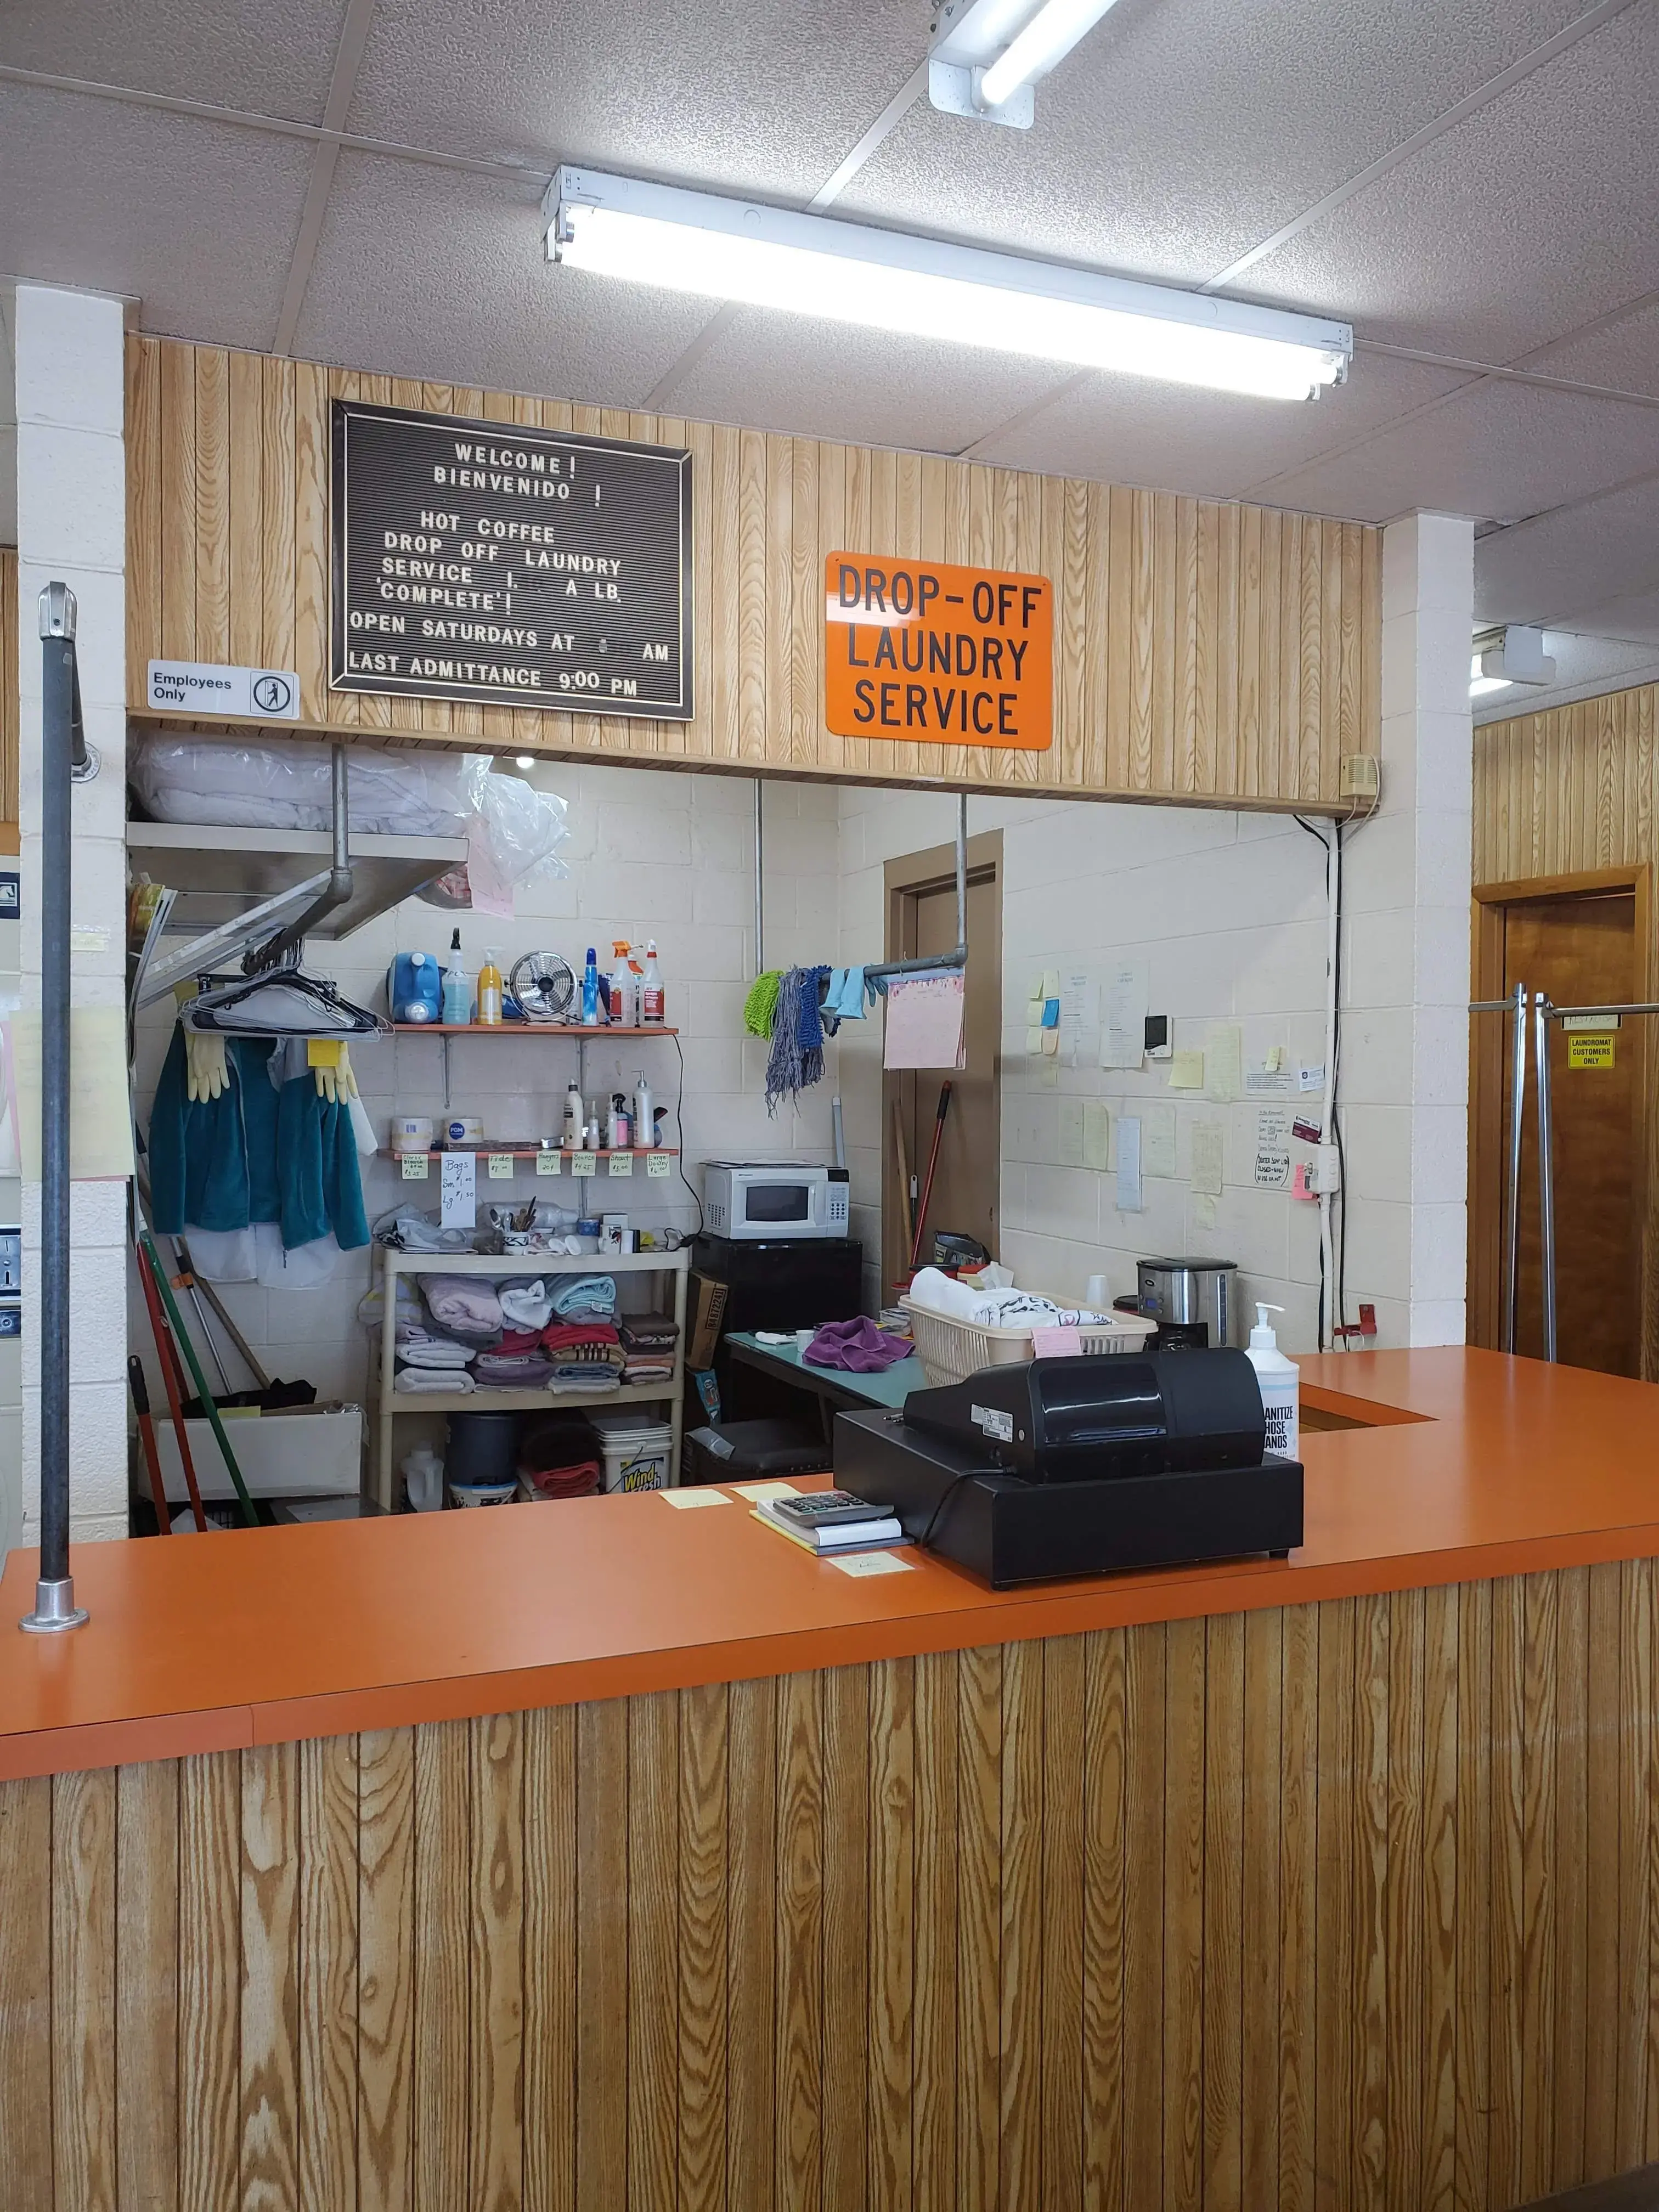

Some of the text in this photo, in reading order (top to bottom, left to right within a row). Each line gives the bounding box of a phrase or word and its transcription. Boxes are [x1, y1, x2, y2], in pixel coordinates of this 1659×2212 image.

[434, 466, 569, 499] BIENVENIDO
[421, 511, 555, 544] HOT COFFEE
[385, 532, 621, 575] DROP OFF LAUNDRY
[382, 557, 472, 584] SERVICE
[566, 579, 577, 596] A
[595, 582, 622, 603] LB.
[839, 564, 1042, 628] DROP-OFF
[349, 612, 668, 661] OPEN SATURDAYS AT AM
[849, 623, 1029, 681] LAUNDRY
[154, 672, 232, 689] Employees
[349, 651, 637, 697] LAST ADMITTANCE 9:00 PM
[154, 687, 186, 702] Only
[853, 679, 1018, 735] SERVICE
[445, 1160, 469, 1176] Bags
[648, 1160, 668, 1169] Downy
[1265, 1406, 1293, 1420] ANITIZE
[1265, 1421, 1285, 1435] HOSE
[1265, 1435, 1288, 1448] ANDS
[624, 1462, 656, 1492] Wind
[633, 1472, 662, 1492] resh
